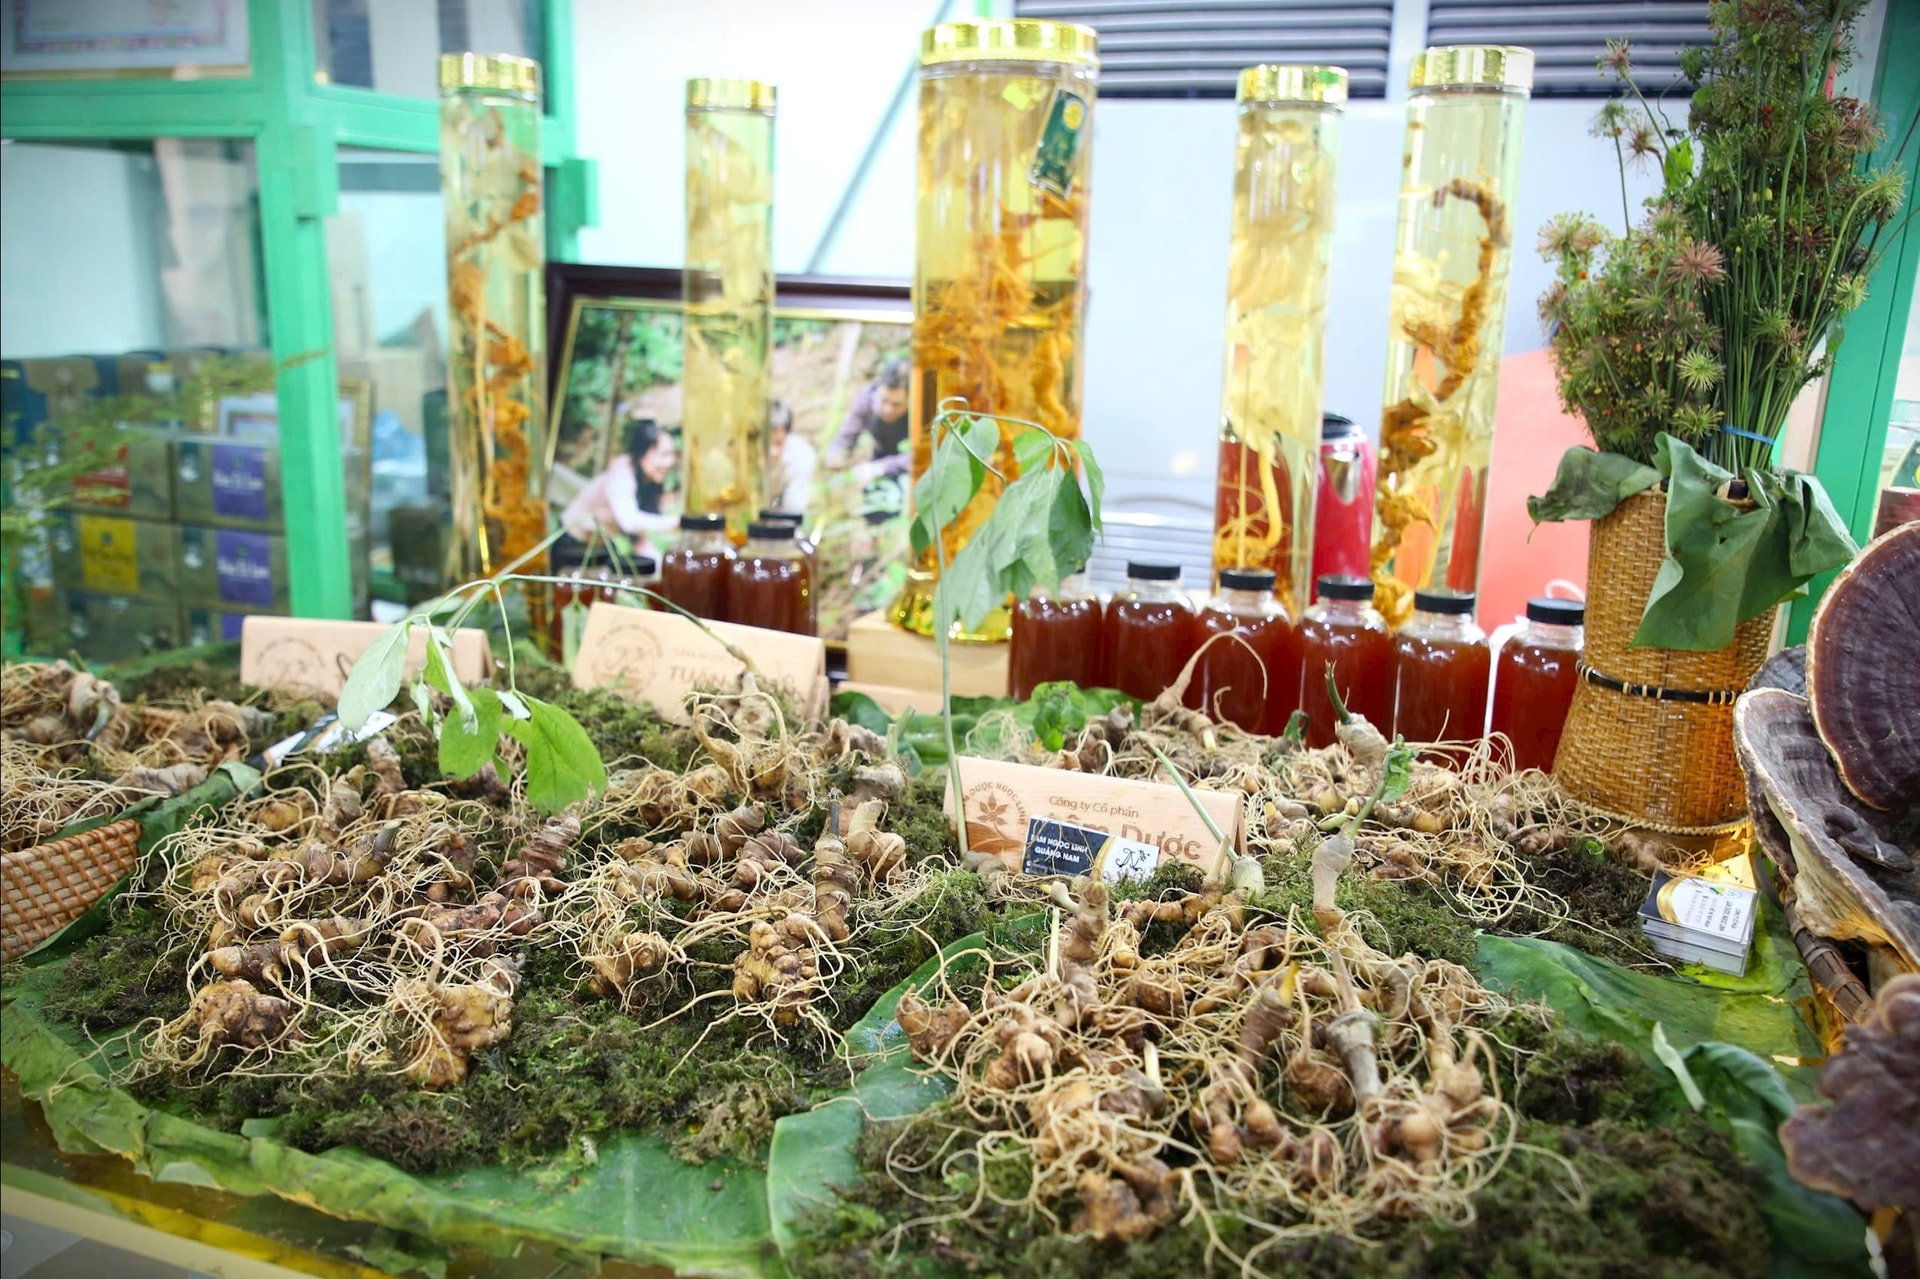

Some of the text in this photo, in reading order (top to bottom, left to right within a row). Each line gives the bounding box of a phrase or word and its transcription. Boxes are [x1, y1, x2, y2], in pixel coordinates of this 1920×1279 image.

[1049, 795, 1077, 810] Công
[1080, 800, 1090, 813] ty
[1062, 852, 1080, 864] NAM
